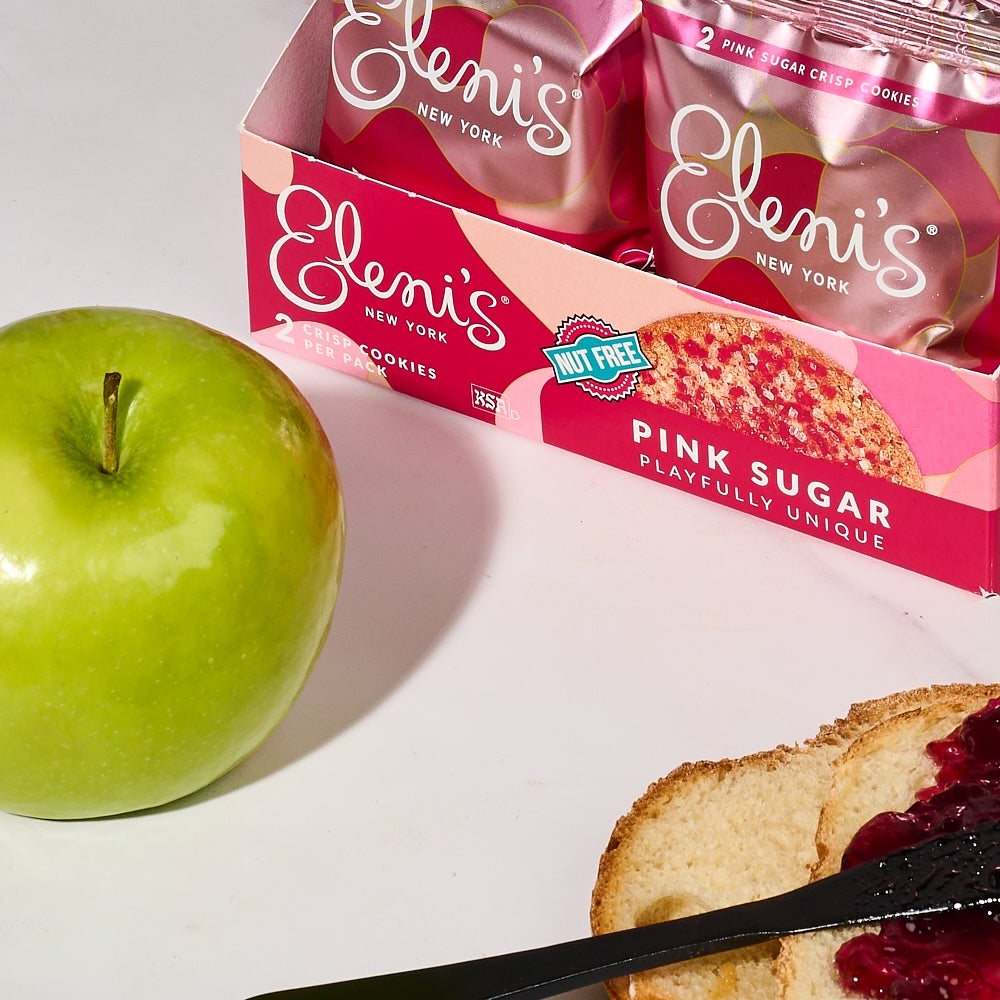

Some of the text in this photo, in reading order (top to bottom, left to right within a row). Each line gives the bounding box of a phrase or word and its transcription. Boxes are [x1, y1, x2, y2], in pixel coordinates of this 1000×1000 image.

[696, 26, 920, 108] 2 PINK SUGAR CRISP COOKIES
[417, 101, 504, 149] NEW YORK
[660, 104, 927, 297] Eleni's
[269, 184, 506, 351] Eleni's
[756, 251, 850, 295] NEW YORK
[274, 313, 437, 380] 2 CRISP COOKIES
[304, 338, 388, 378] PER PACK
[365, 306, 448, 344] NEW YORK
[553, 340, 643, 376] NUT FREE
[632, 419, 892, 529] PINK SUGAR
[640, 453, 885, 551] PLAYFULLY UNIQUE
